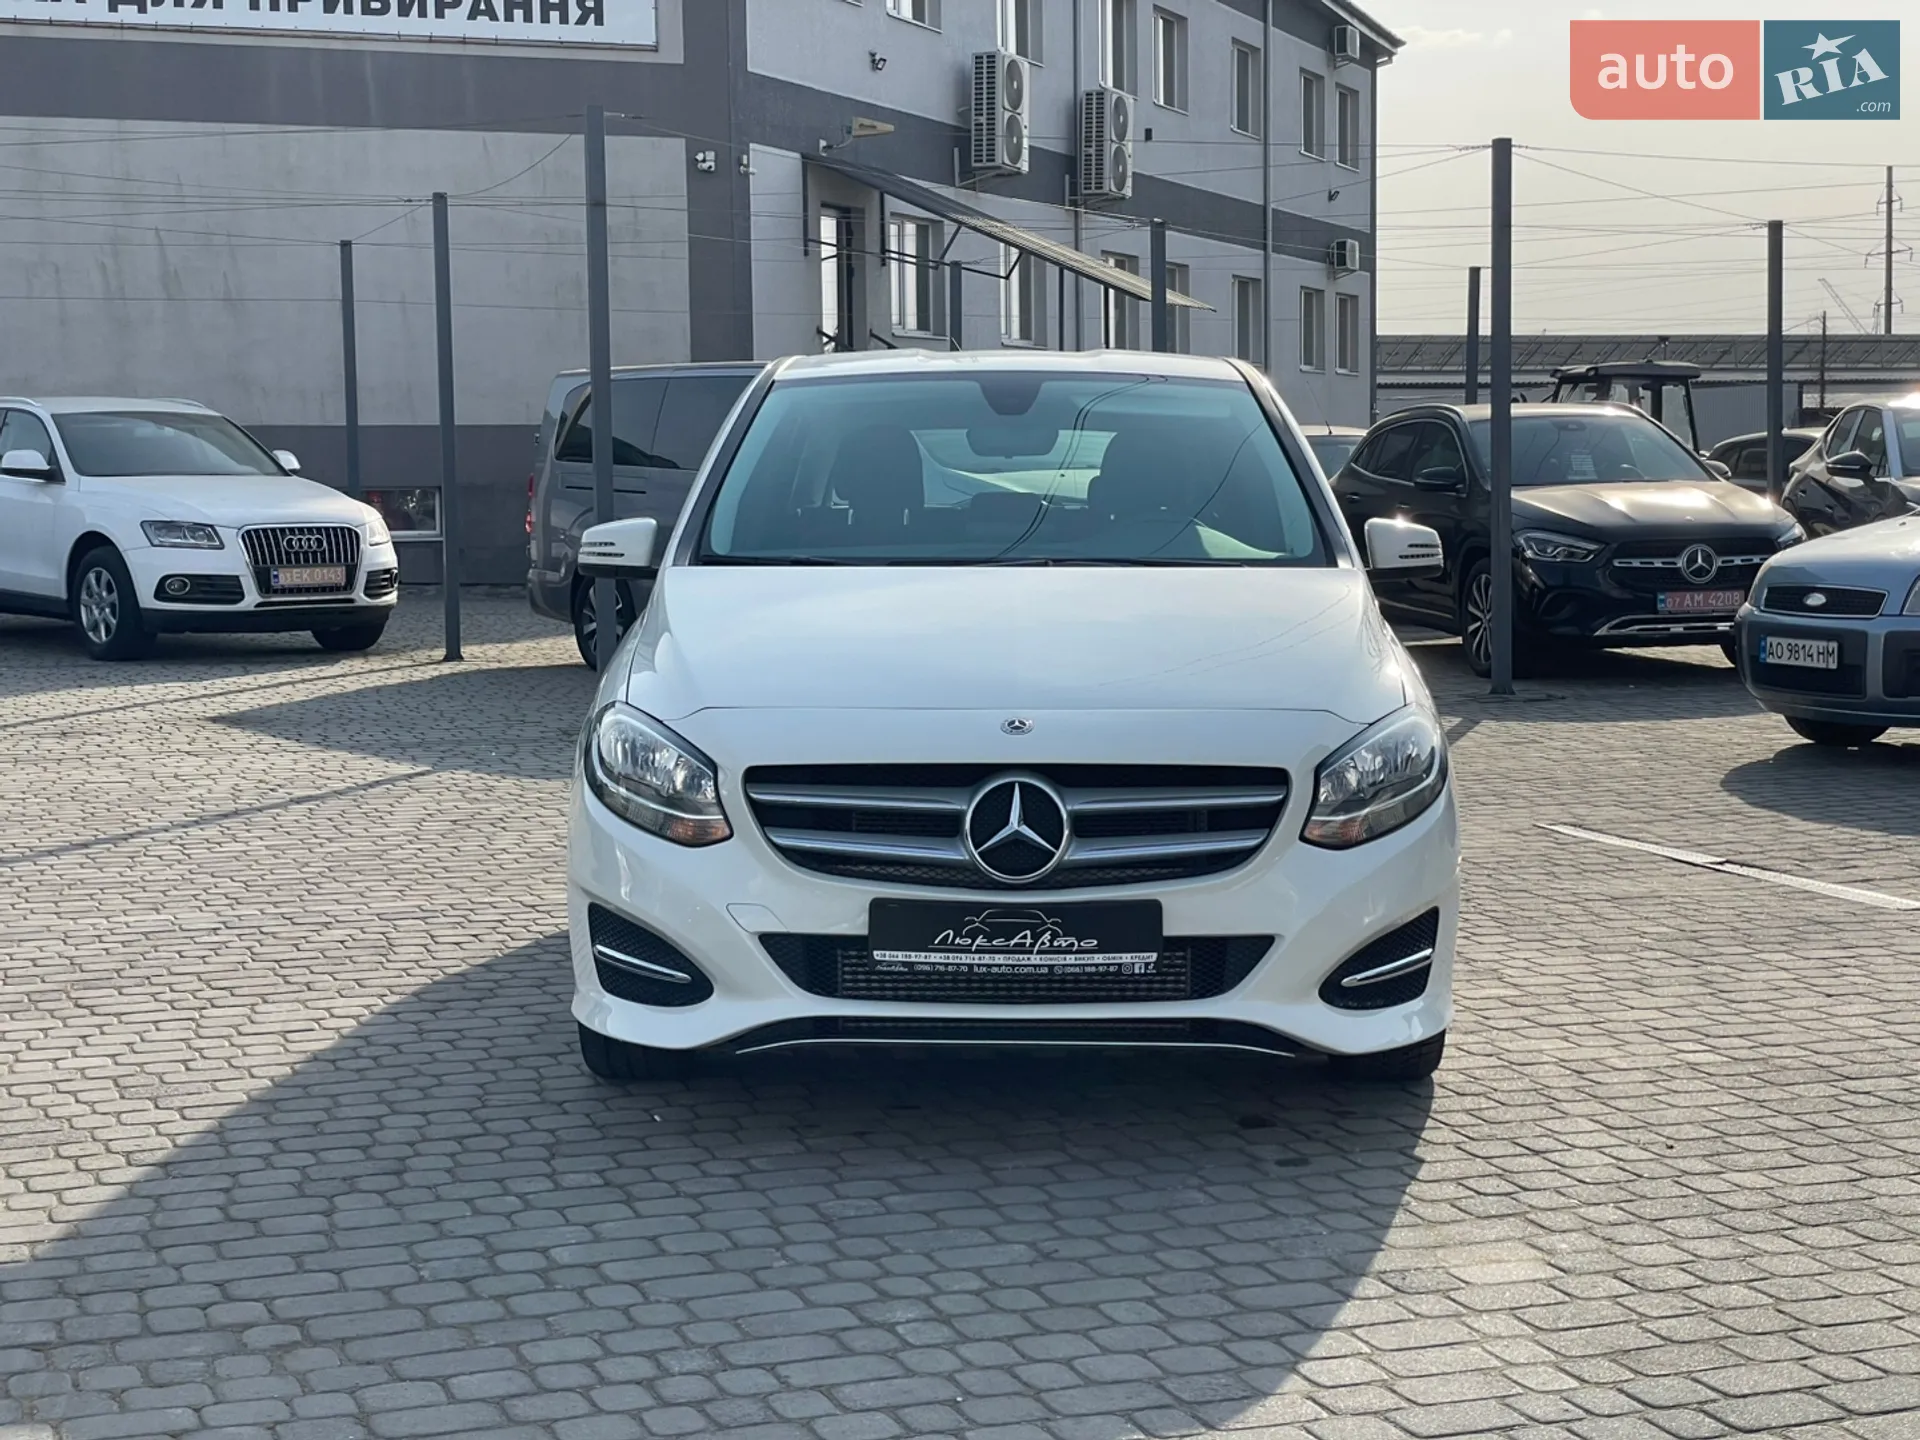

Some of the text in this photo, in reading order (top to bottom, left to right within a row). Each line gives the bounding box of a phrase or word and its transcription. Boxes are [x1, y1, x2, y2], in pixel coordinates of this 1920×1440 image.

[292, 568, 311, 582] EK
[1666, 591, 1740, 608] 07 AM 4208
[1768, 641, 1836, 665] AO 9814 HM
[973, 964, 1048, 974] lux-auto.com.ua
